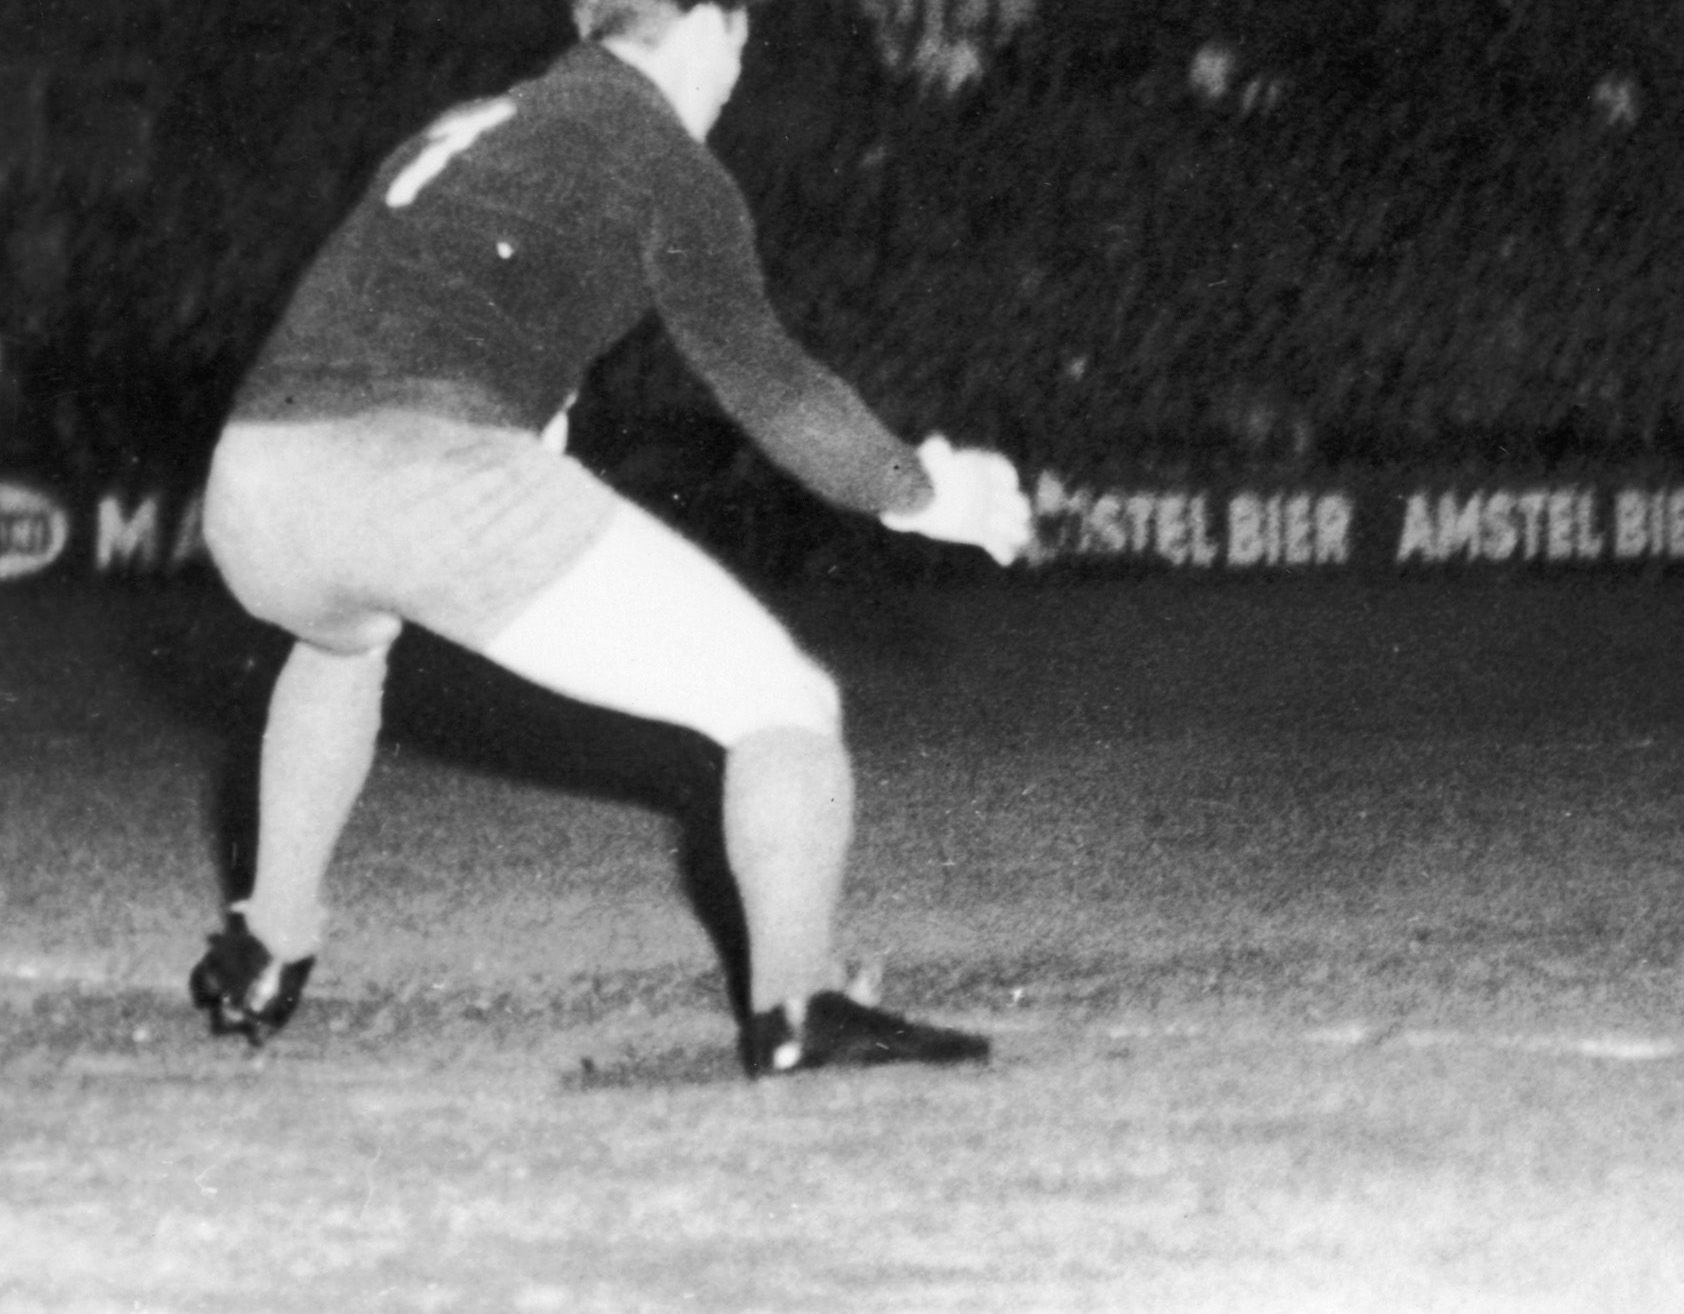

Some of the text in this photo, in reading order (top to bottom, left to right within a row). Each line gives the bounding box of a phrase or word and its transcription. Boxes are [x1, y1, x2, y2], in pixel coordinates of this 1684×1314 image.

[1052, 492, 1351, 565] STEL BIER
[1397, 489, 1601, 562] AMSTEL
